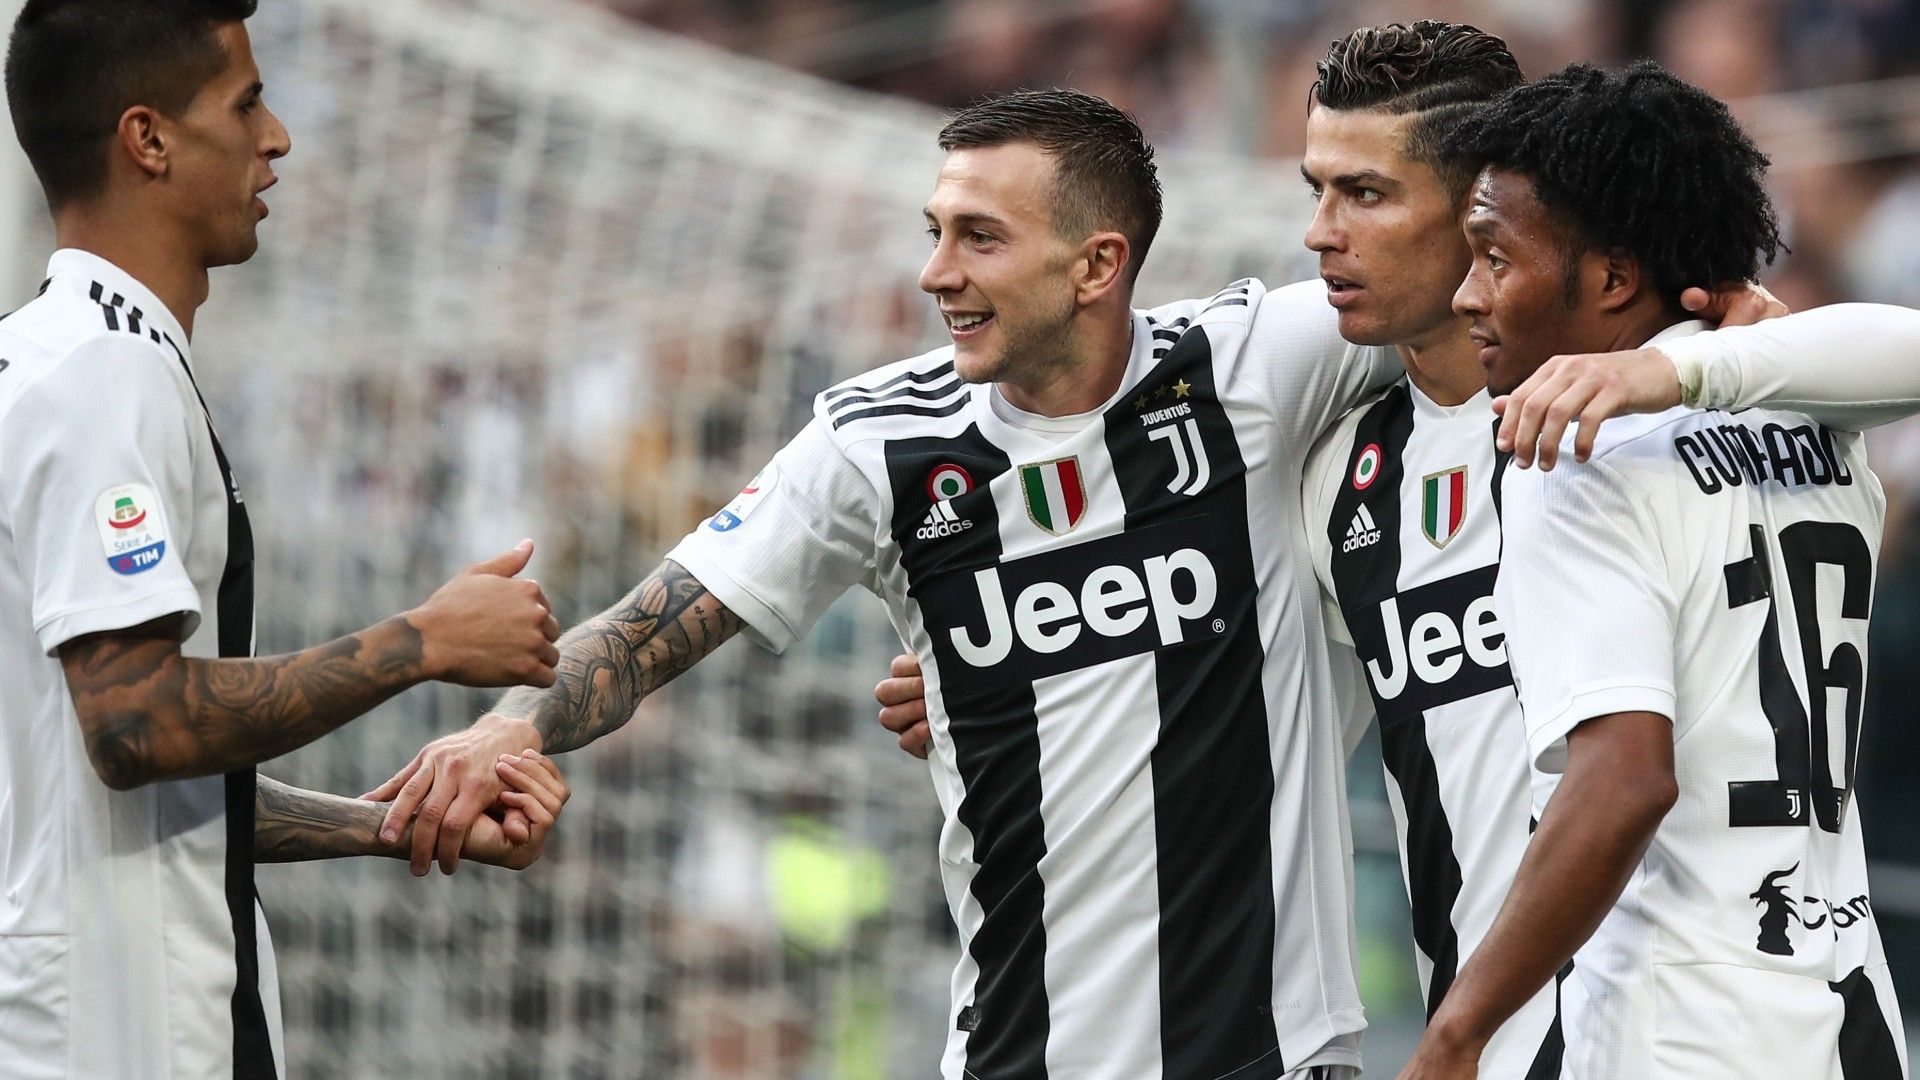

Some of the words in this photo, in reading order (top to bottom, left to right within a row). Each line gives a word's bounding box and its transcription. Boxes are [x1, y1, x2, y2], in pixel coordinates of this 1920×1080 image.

[1140, 402, 1192, 426] JUVENTUS
[916, 519, 974, 540] adidas
[1342, 530, 1381, 553] adidas
[132, 547, 159, 567] TIM
[949, 548, 1218, 668] Jeep
[1724, 520, 1872, 834] 16
